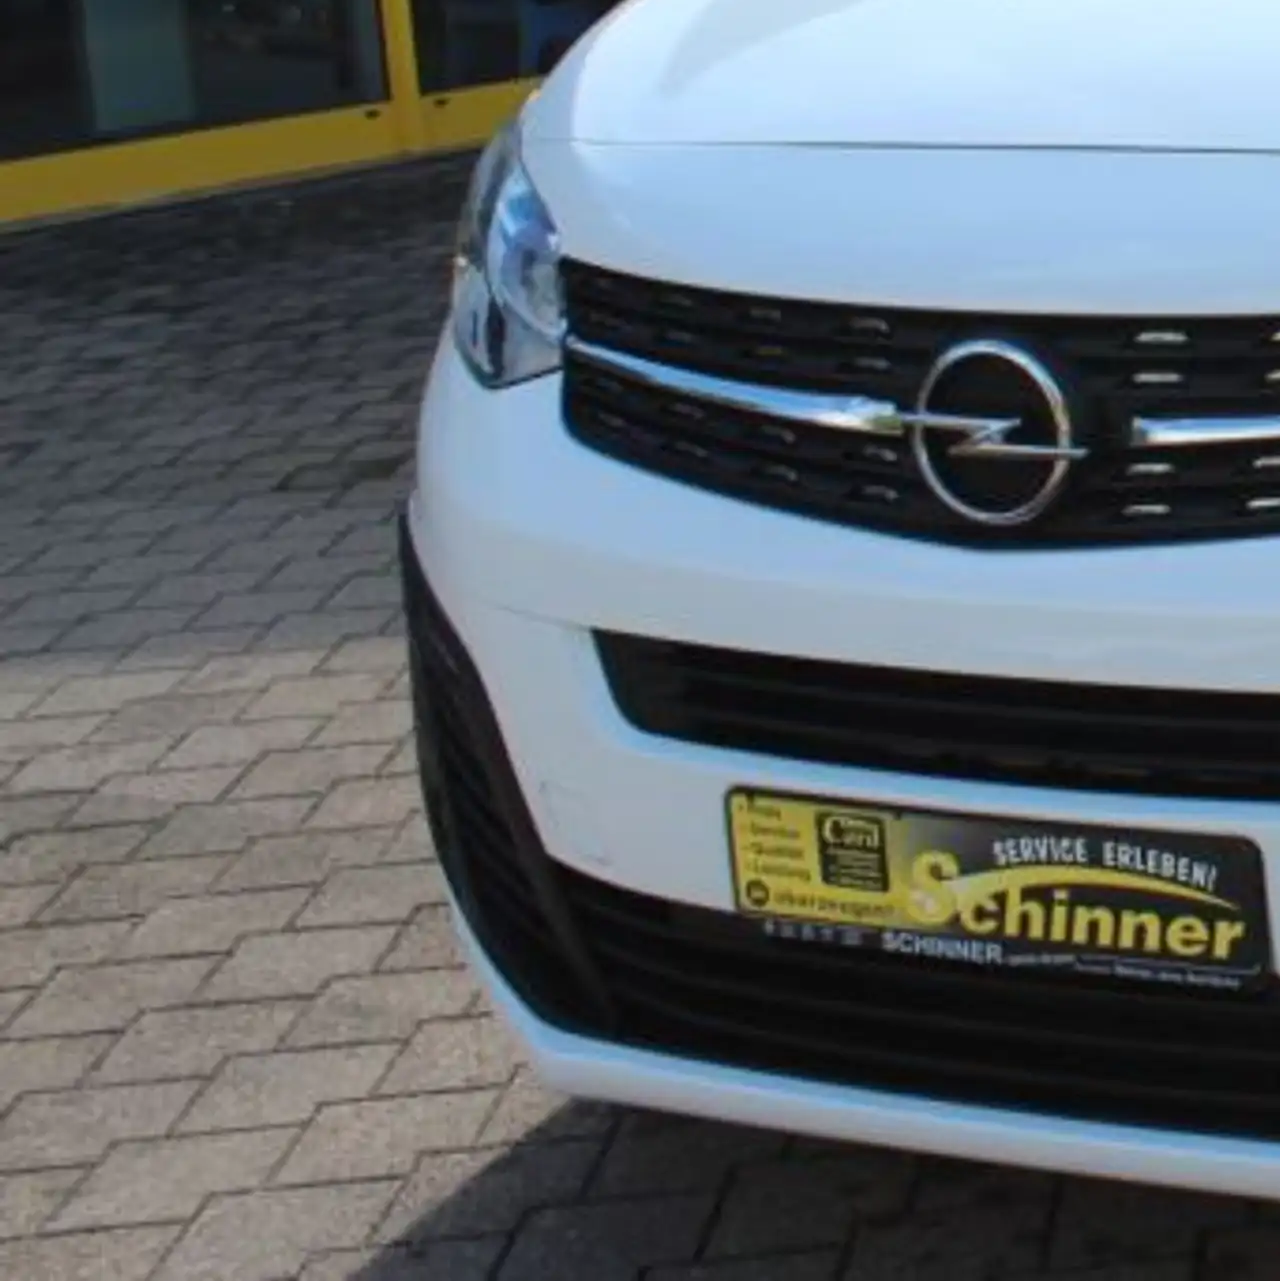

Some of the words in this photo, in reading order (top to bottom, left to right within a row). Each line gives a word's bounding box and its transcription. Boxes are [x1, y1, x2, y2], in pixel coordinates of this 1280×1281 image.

[992, 834, 1088, 865] SERVICE
[1102, 840, 1218, 892] ERLEBEN!
[907, 850, 1246, 961] Schinner
[881, 931, 1003, 966] SCHINNER
